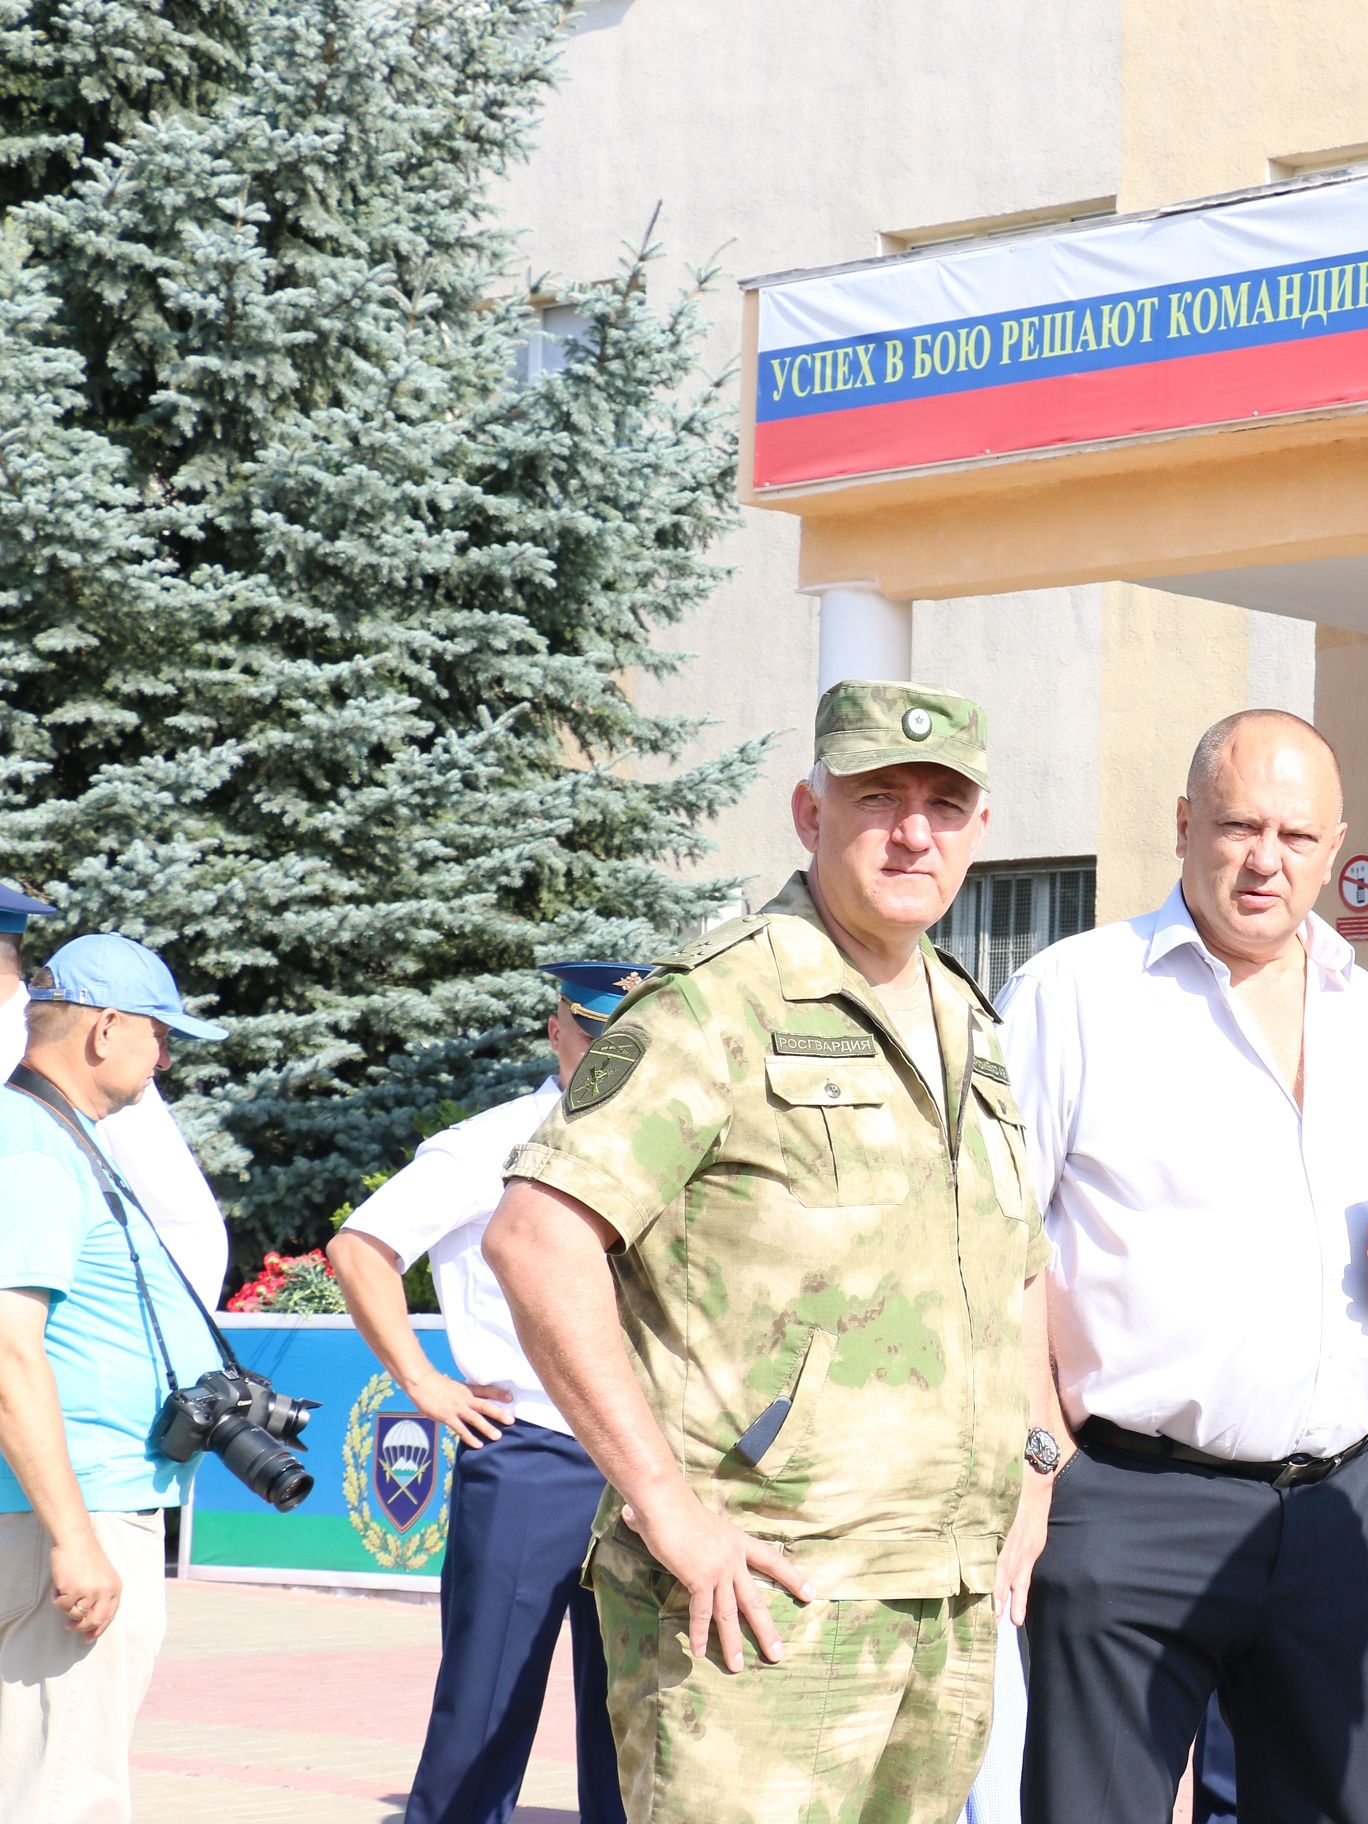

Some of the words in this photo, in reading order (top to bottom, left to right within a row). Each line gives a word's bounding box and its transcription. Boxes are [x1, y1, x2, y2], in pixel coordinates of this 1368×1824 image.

[769, 345, 876, 402] УСПЕХ
[884, 339, 905, 384] В
[911, 325, 992, 379] БОЮ
[999, 298, 1159, 365] РЕШАЮТ
[779, 1037, 871, 1052] РОСГВАРДИЯ
